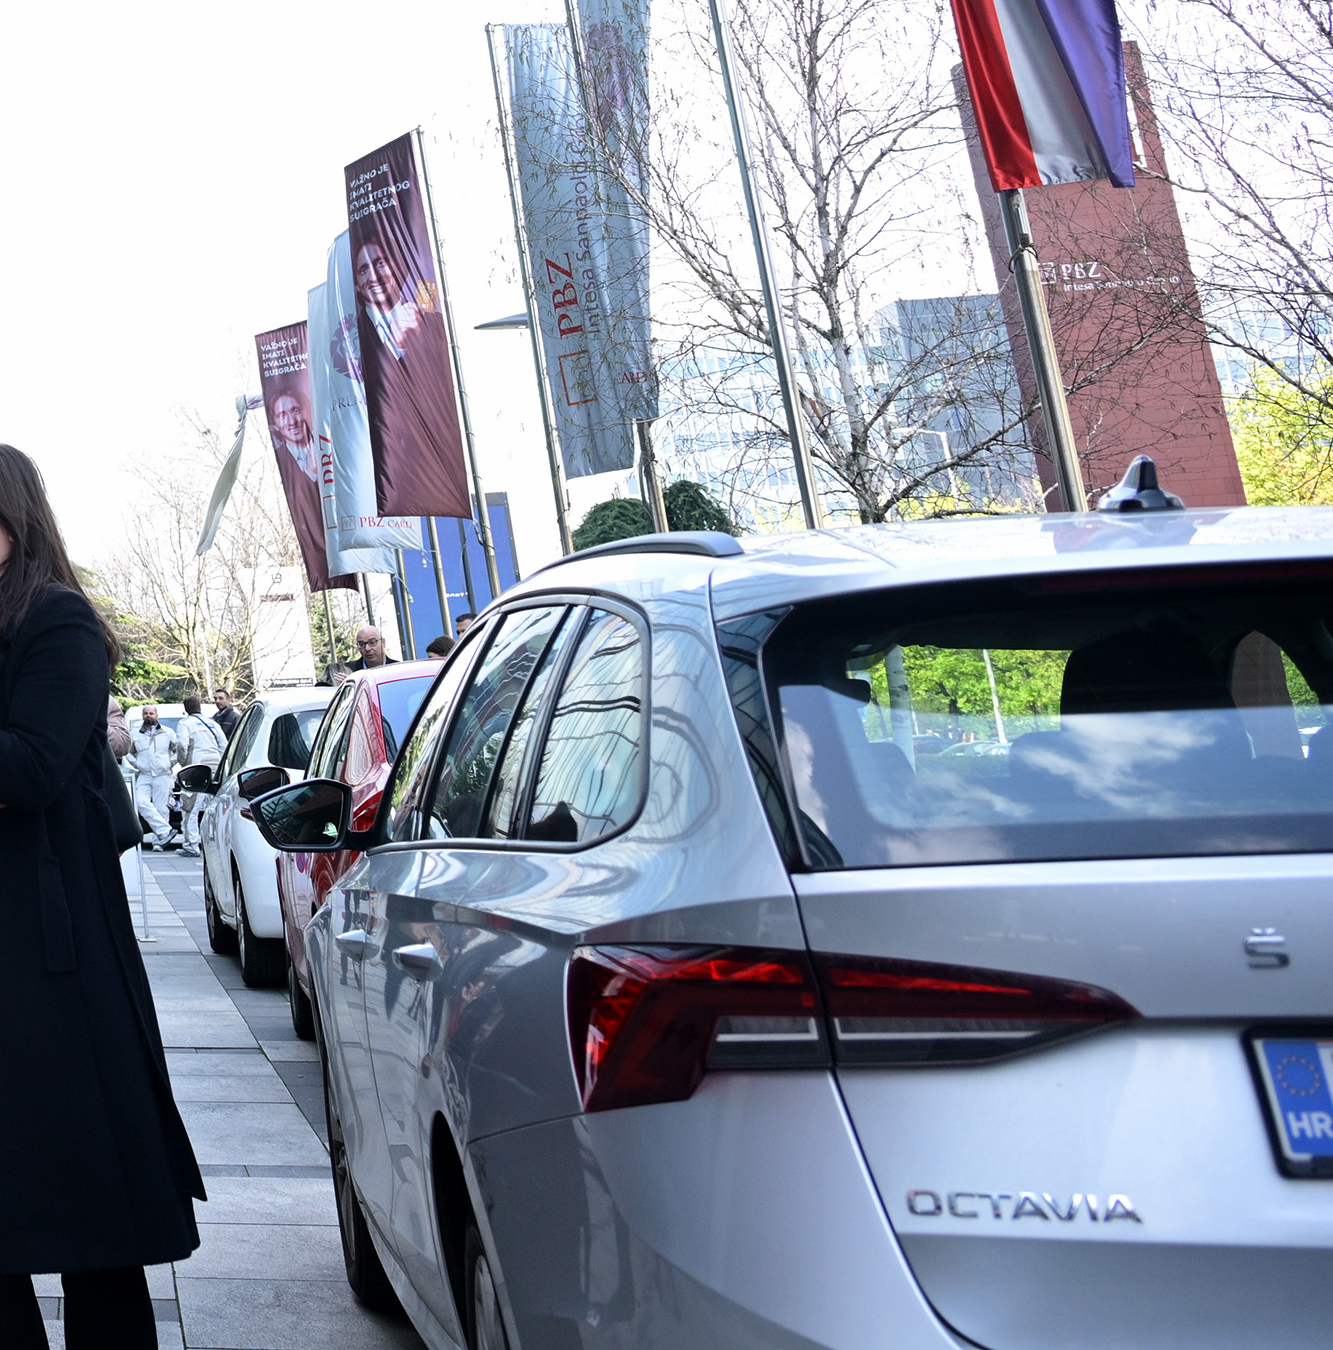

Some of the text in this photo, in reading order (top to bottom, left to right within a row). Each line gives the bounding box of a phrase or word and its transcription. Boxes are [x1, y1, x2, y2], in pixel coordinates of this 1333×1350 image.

[350, 163, 389, 188] VAŽNO JE
[349, 182, 373, 200] IMATI
[349, 180, 411, 211] KVALITETNOG
[349, 197, 397, 223] SUIGRAČA
[1060, 261, 1101, 280] PBZ
[545, 252, 583, 340] PBZ
[582, 268, 601, 334] Intesa
[288, 337, 298, 346] JE
[262, 350, 285, 360] IMATI
[359, 516, 385, 528] PBZ
[1287, 1111, 1333, 1139] HR
[906, 1189, 1144, 1225] OCTAVIA
